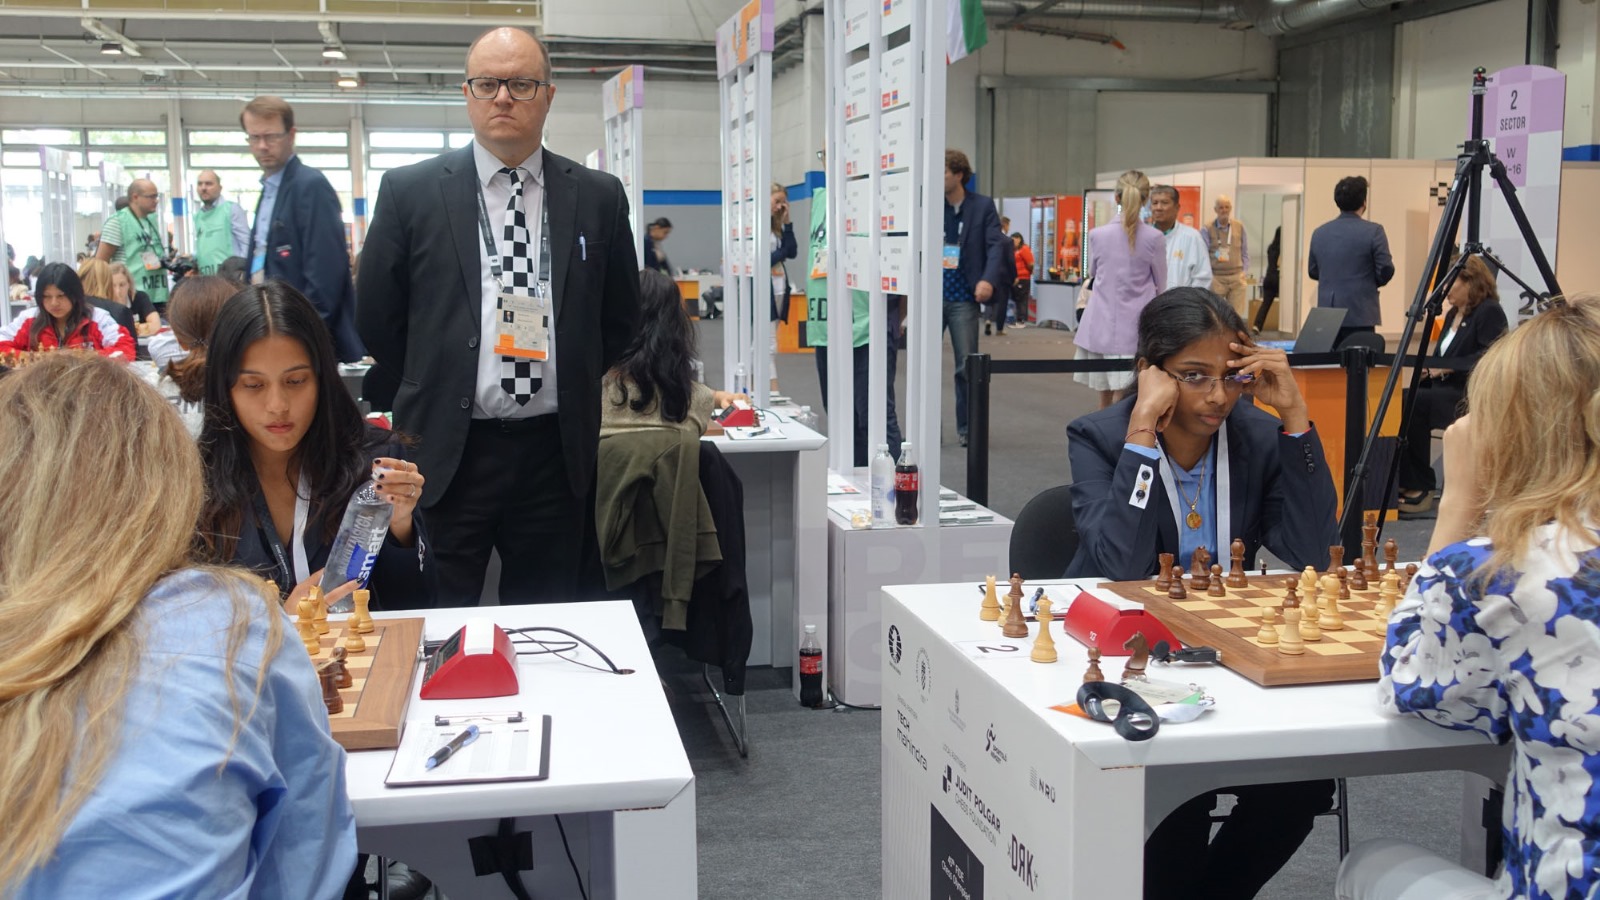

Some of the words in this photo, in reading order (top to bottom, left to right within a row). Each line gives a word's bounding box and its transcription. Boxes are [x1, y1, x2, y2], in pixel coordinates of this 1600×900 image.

[1510, 90, 1518, 110] 2
[1500, 116, 1526, 131] SECTOR
[1507, 148, 1516, 159] W
[358, 526, 388, 582] smart
[897, 709, 910, 732] TECH
[896, 728, 928, 771] mahindra
[954, 793, 969, 816] CHESS
[969, 808, 997, 847] FOUNDATION
[955, 775, 972, 801] JUDIT
[974, 794, 1001, 834] POLGAR
